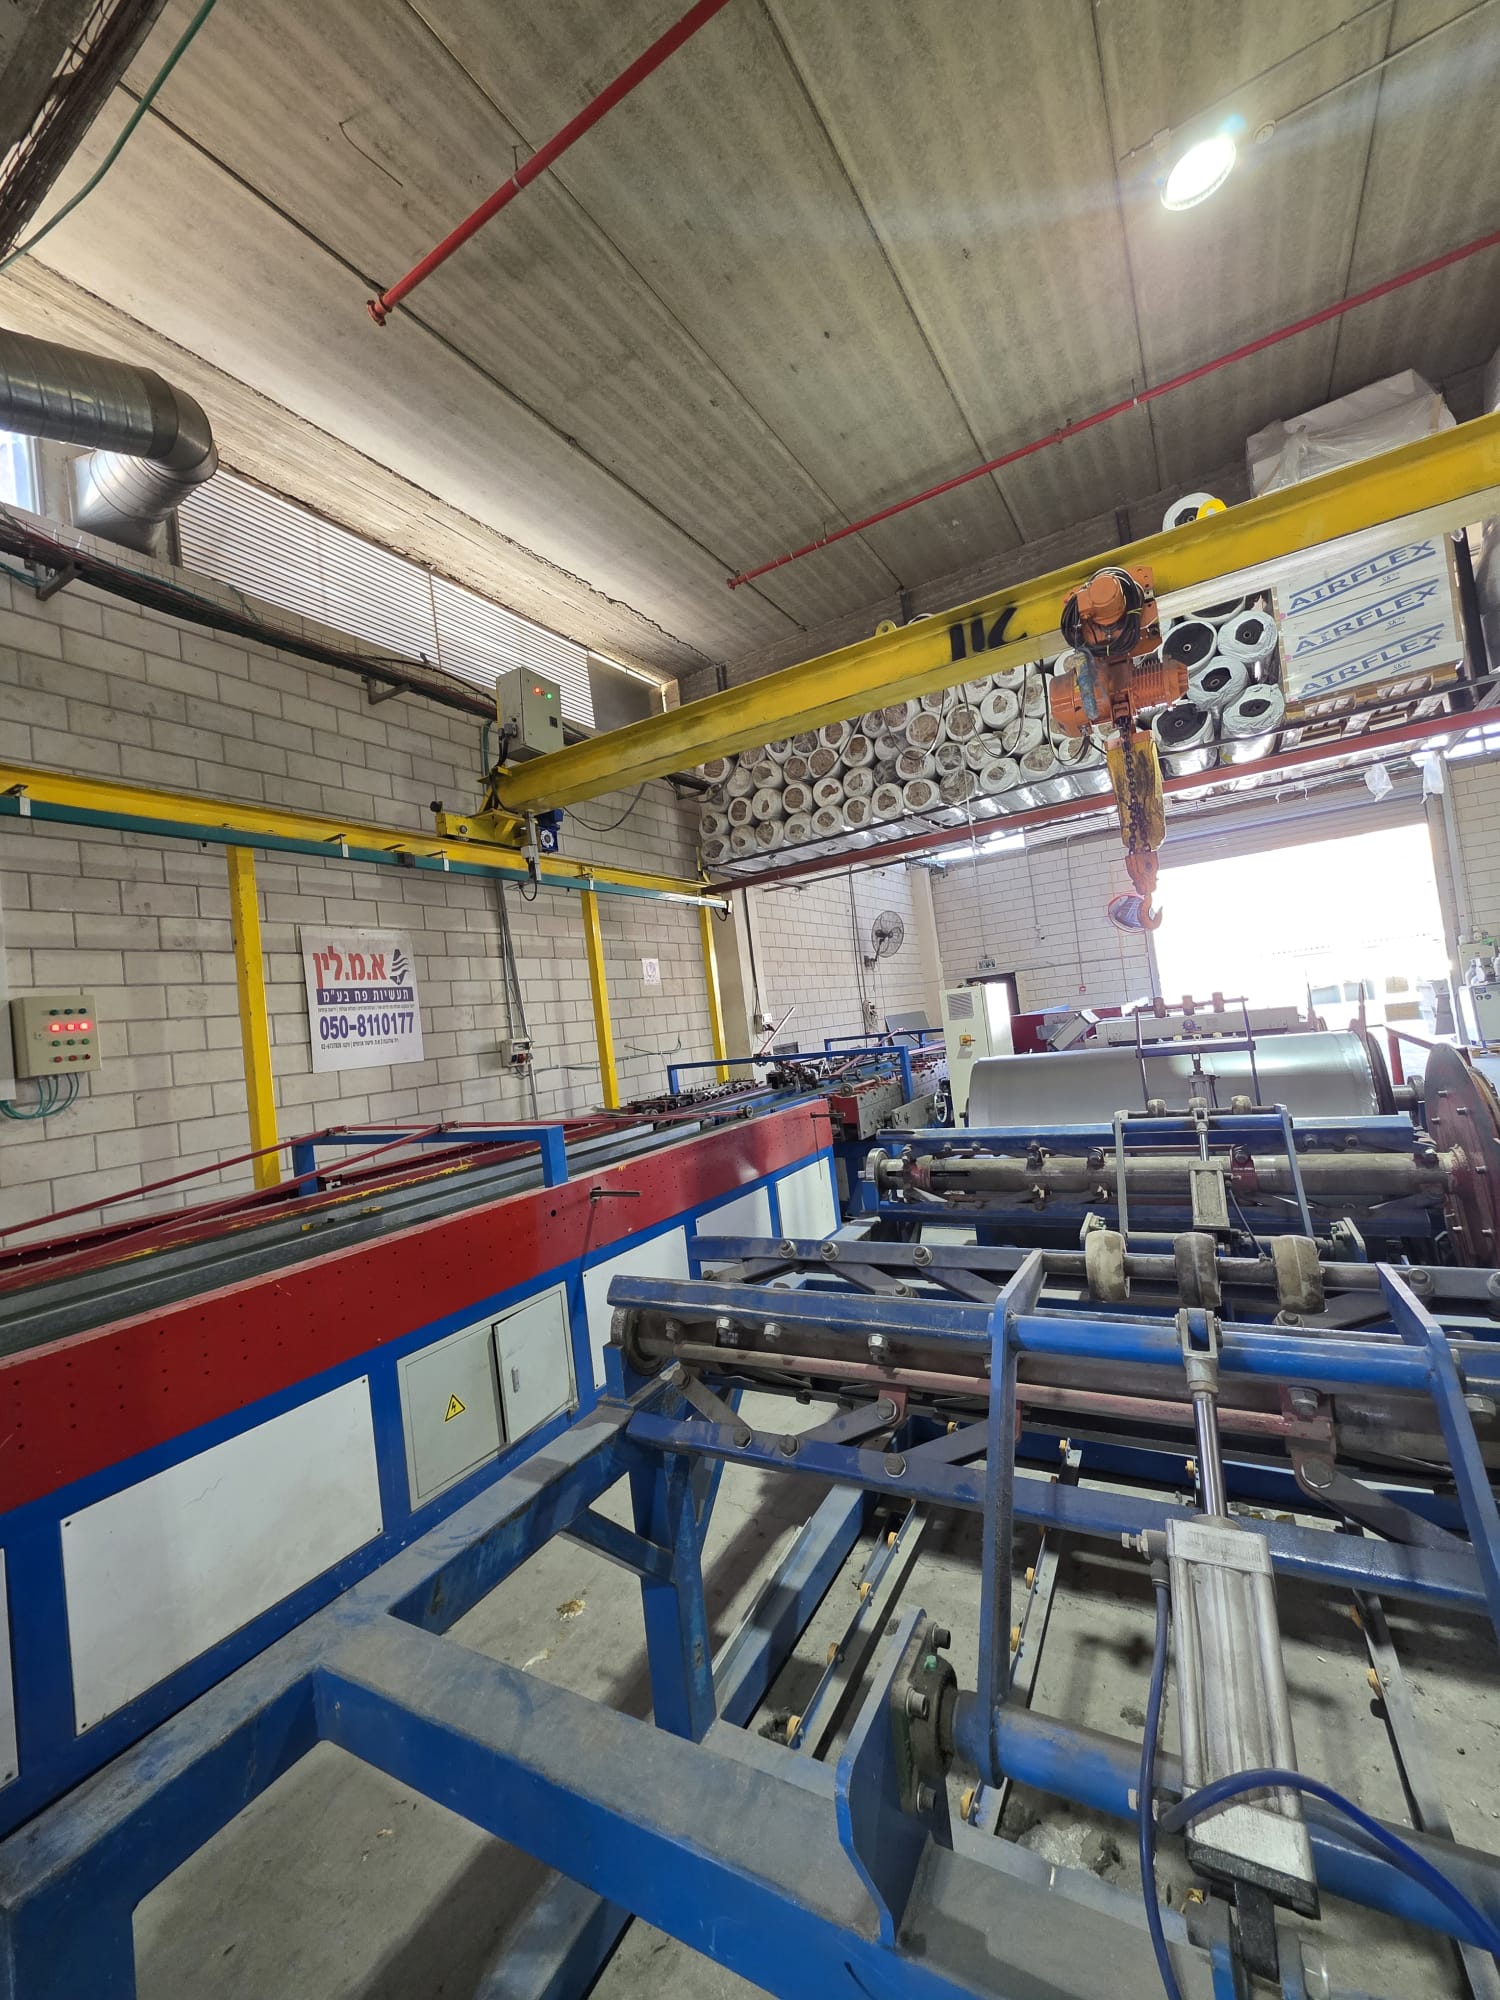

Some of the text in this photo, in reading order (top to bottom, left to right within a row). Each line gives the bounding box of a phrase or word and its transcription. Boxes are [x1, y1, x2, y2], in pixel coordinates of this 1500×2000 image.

[1290, 540, 1435, 609] AIRFLEX
[1296, 585, 1438, 652] AIRFLEX
[1301, 630, 1442, 693] AIRFLEX
[312, 946, 387, 990] א.מ.לין
[322, 989, 409, 1003] תעשיות פח בע"מ
[319, 1012, 414, 1040] 050-8110177
